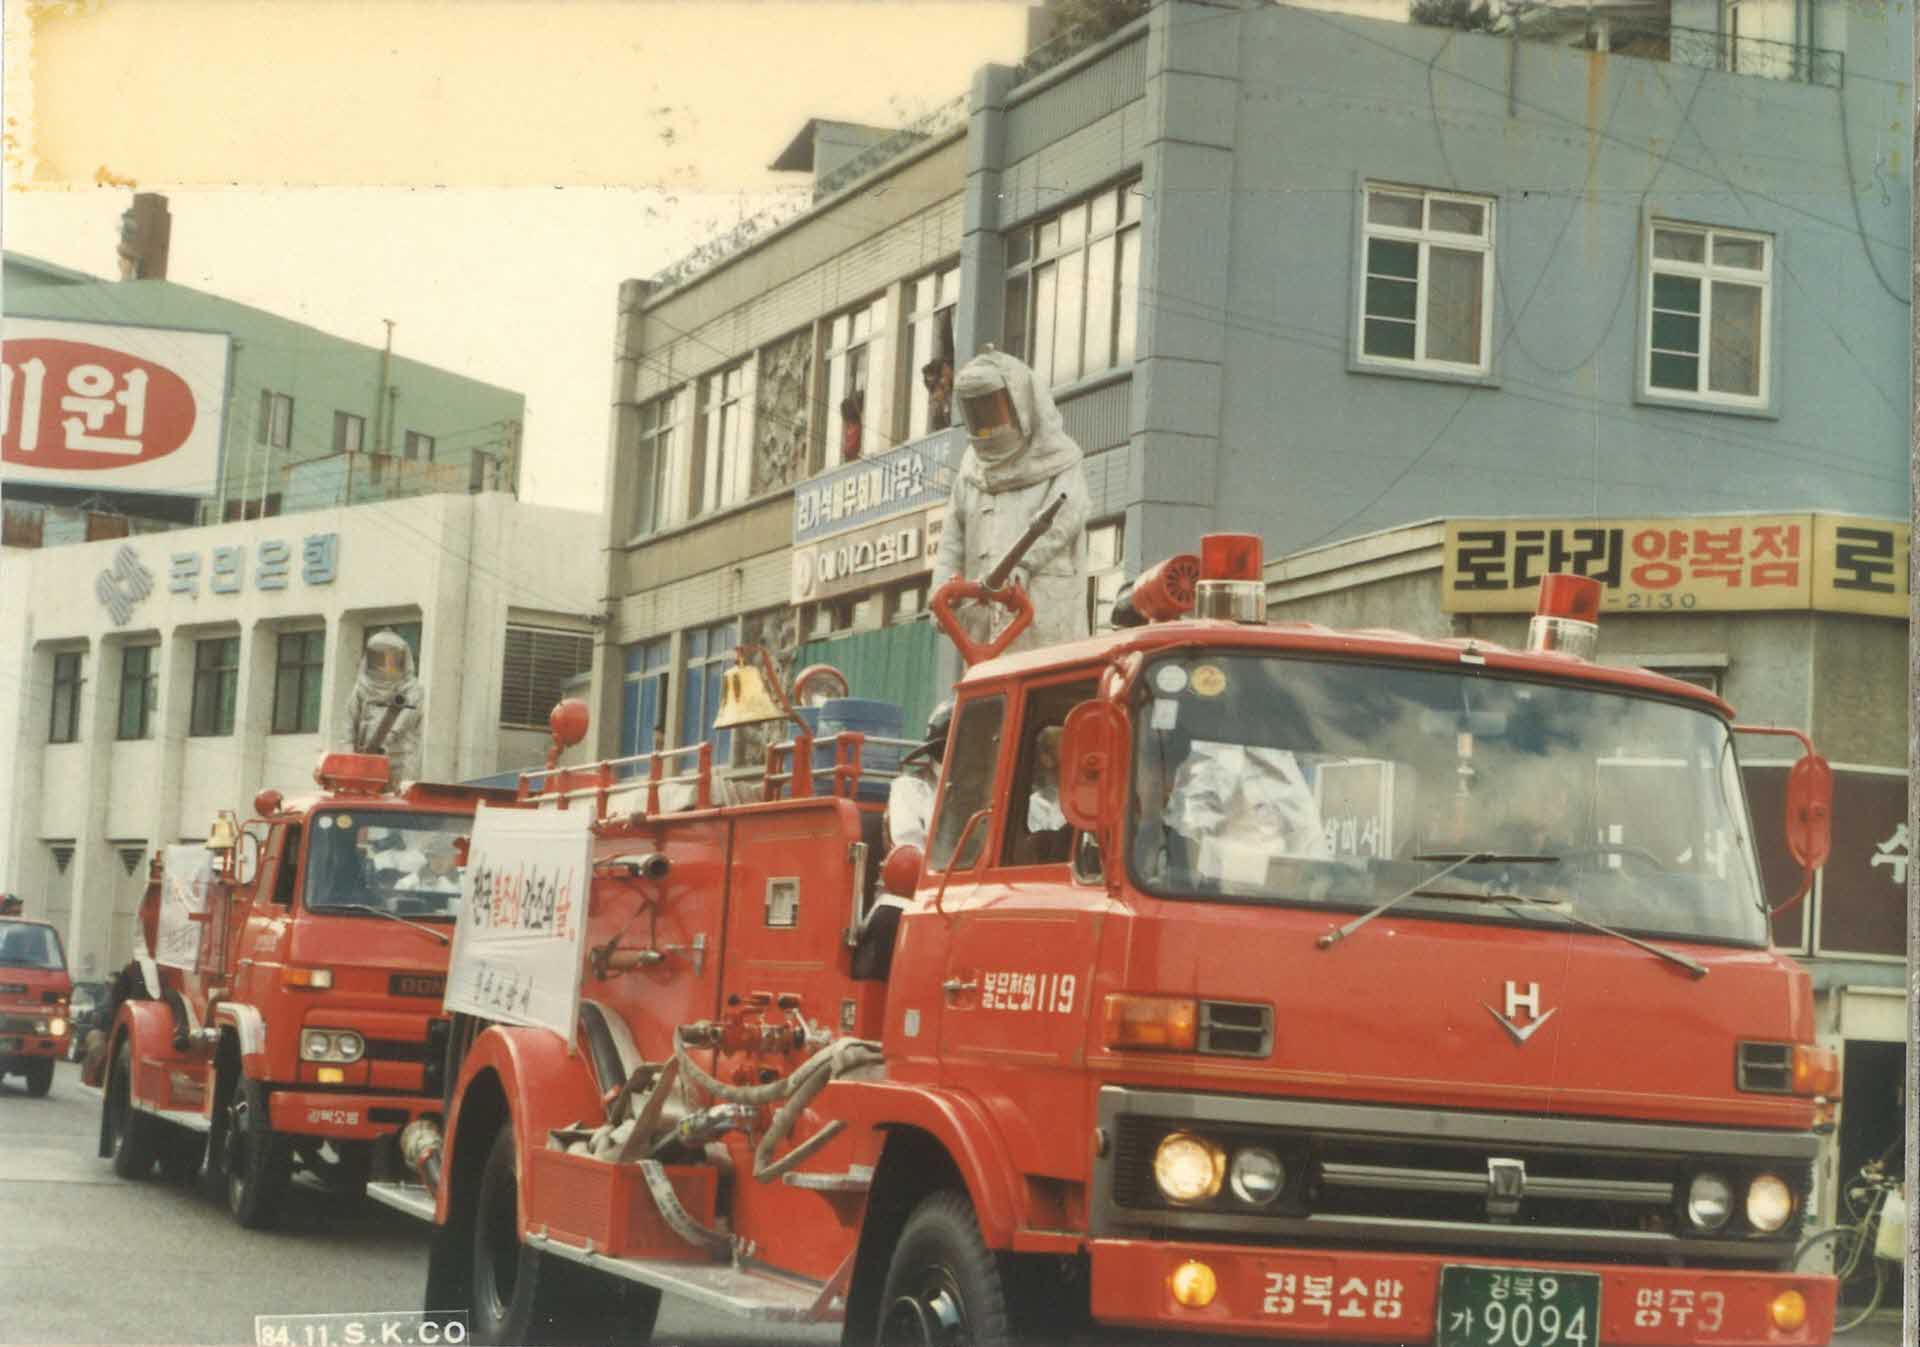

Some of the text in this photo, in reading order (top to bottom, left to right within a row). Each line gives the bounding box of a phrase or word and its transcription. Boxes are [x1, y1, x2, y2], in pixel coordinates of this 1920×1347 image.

[168, 532, 338, 599] 국민은행
[1504, 979, 1540, 1019] H
[1263, 1271, 1404, 1320] 경북소방
